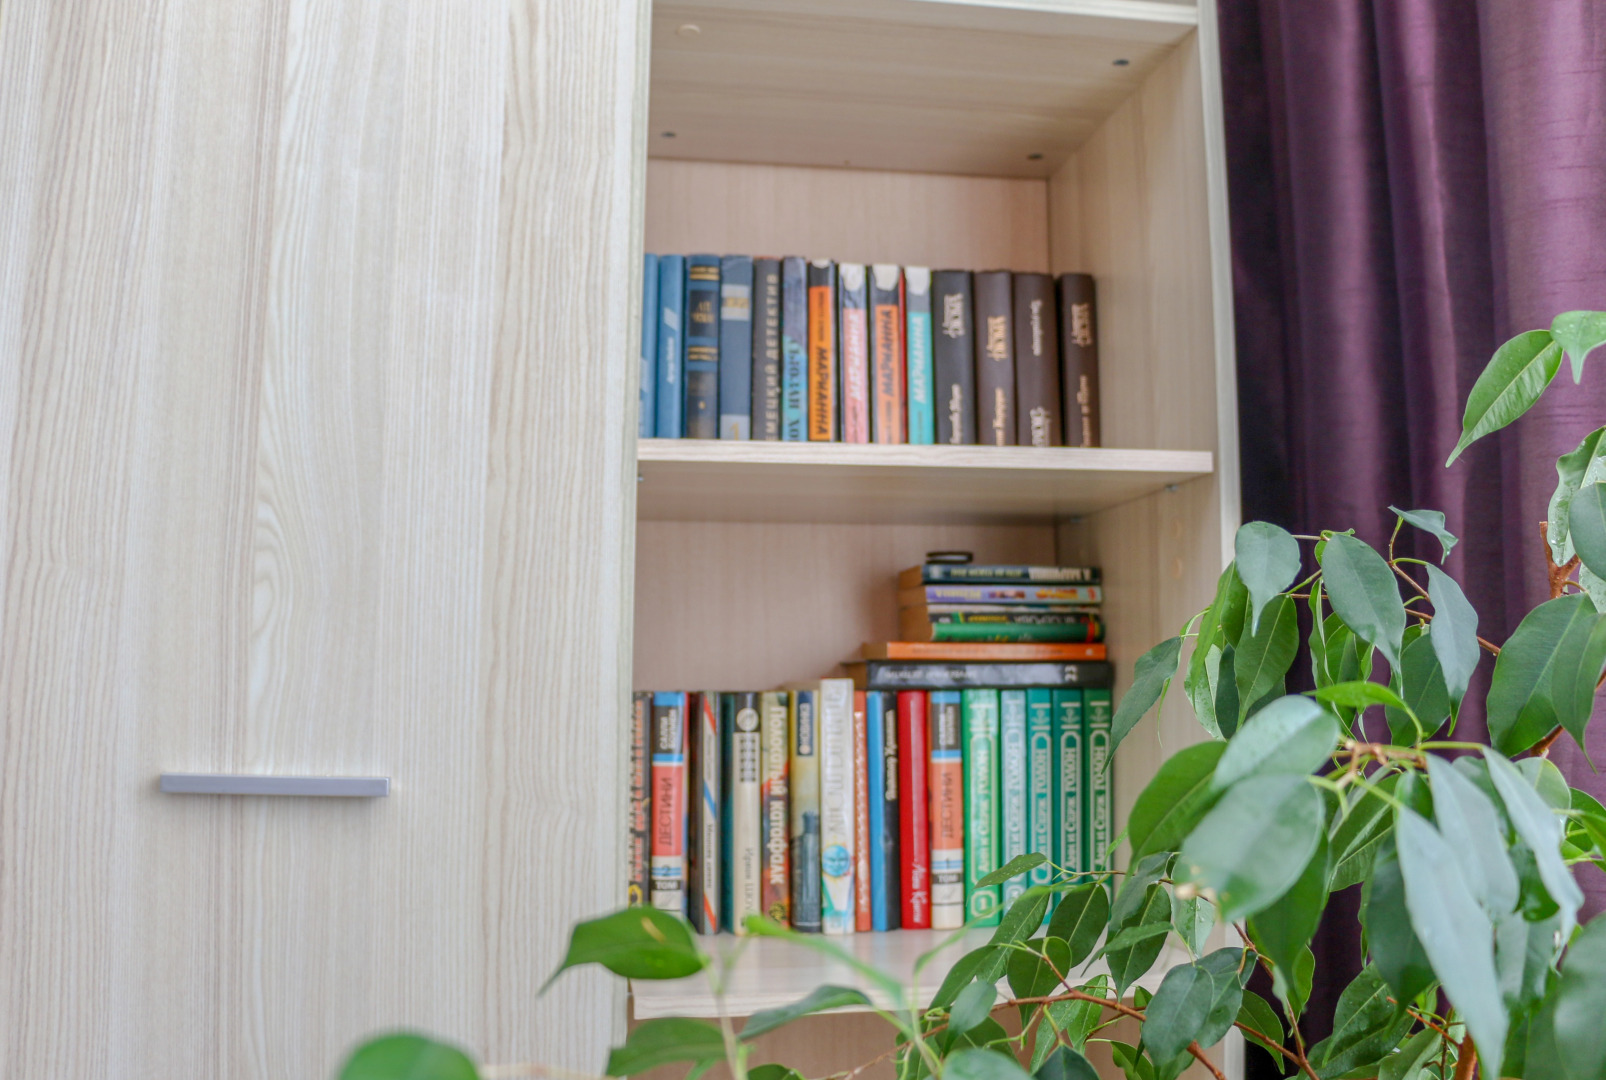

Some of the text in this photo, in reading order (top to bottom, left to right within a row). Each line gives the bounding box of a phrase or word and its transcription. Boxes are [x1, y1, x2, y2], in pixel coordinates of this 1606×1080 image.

[765, 273, 779, 360] ДЕТЕКТИВ
[849, 313, 862, 401] МАРИАННА
[881, 309, 894, 397] МАРИАННА
[913, 316, 927, 404] МАРИАННА
[815, 346, 829, 435] МАРИАННА
[768, 706, 788, 795] Полосатый
[1035, 748, 1047, 794] ГОЛОН
[1064, 747, 1076, 792] ГОЛОН
[1093, 746, 1105, 790] ГОЛОН
[658, 777, 673, 846] ДЕСТИНИ
[940, 772, 954, 839] ДЕСТИНИ
[662, 864, 671, 876] 2
[767, 800, 788, 885] катафалк
[978, 847, 989, 872] Анн
[1065, 843, 1076, 868] Анн
[655, 881, 678, 890] ТОМ
